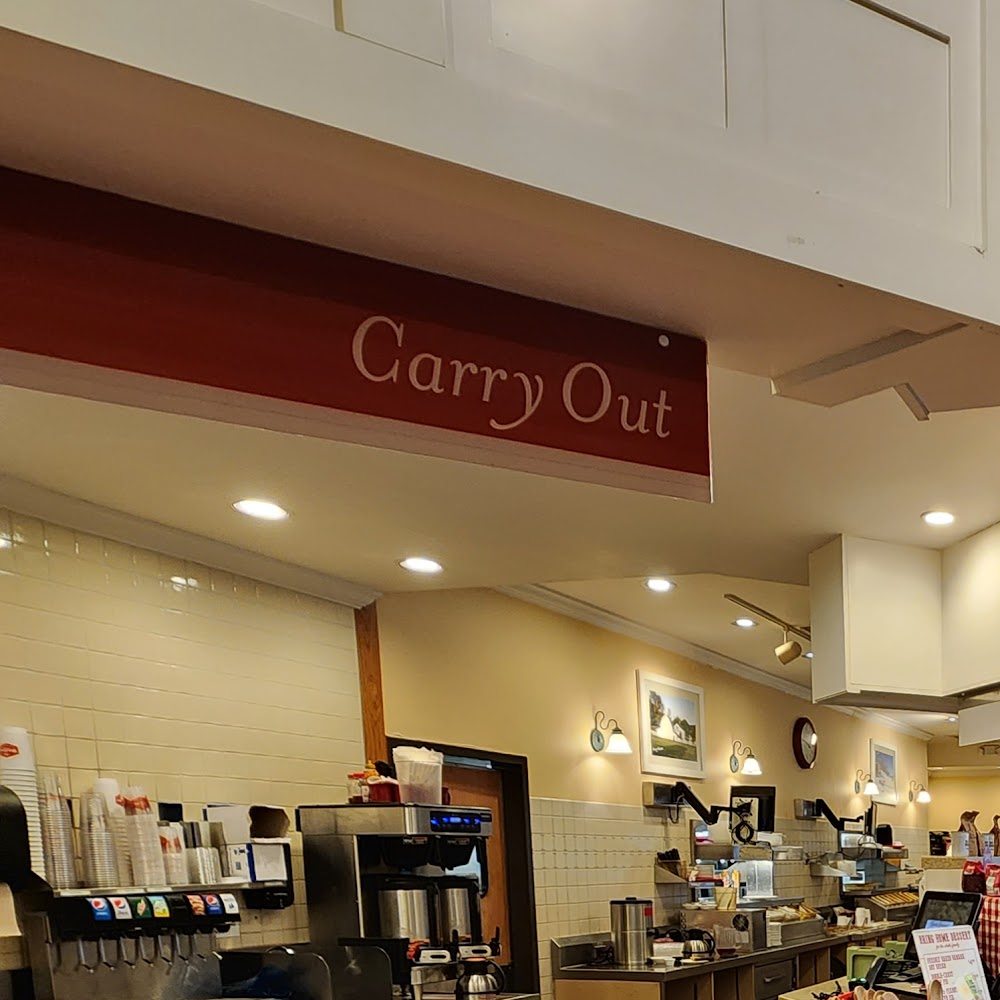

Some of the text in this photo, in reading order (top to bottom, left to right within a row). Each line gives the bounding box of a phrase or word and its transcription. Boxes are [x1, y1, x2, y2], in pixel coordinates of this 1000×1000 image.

[352, 315, 672, 438] Carry Out
[935, 933, 950, 943] HOME
[950, 931, 971, 941] DESSERT
